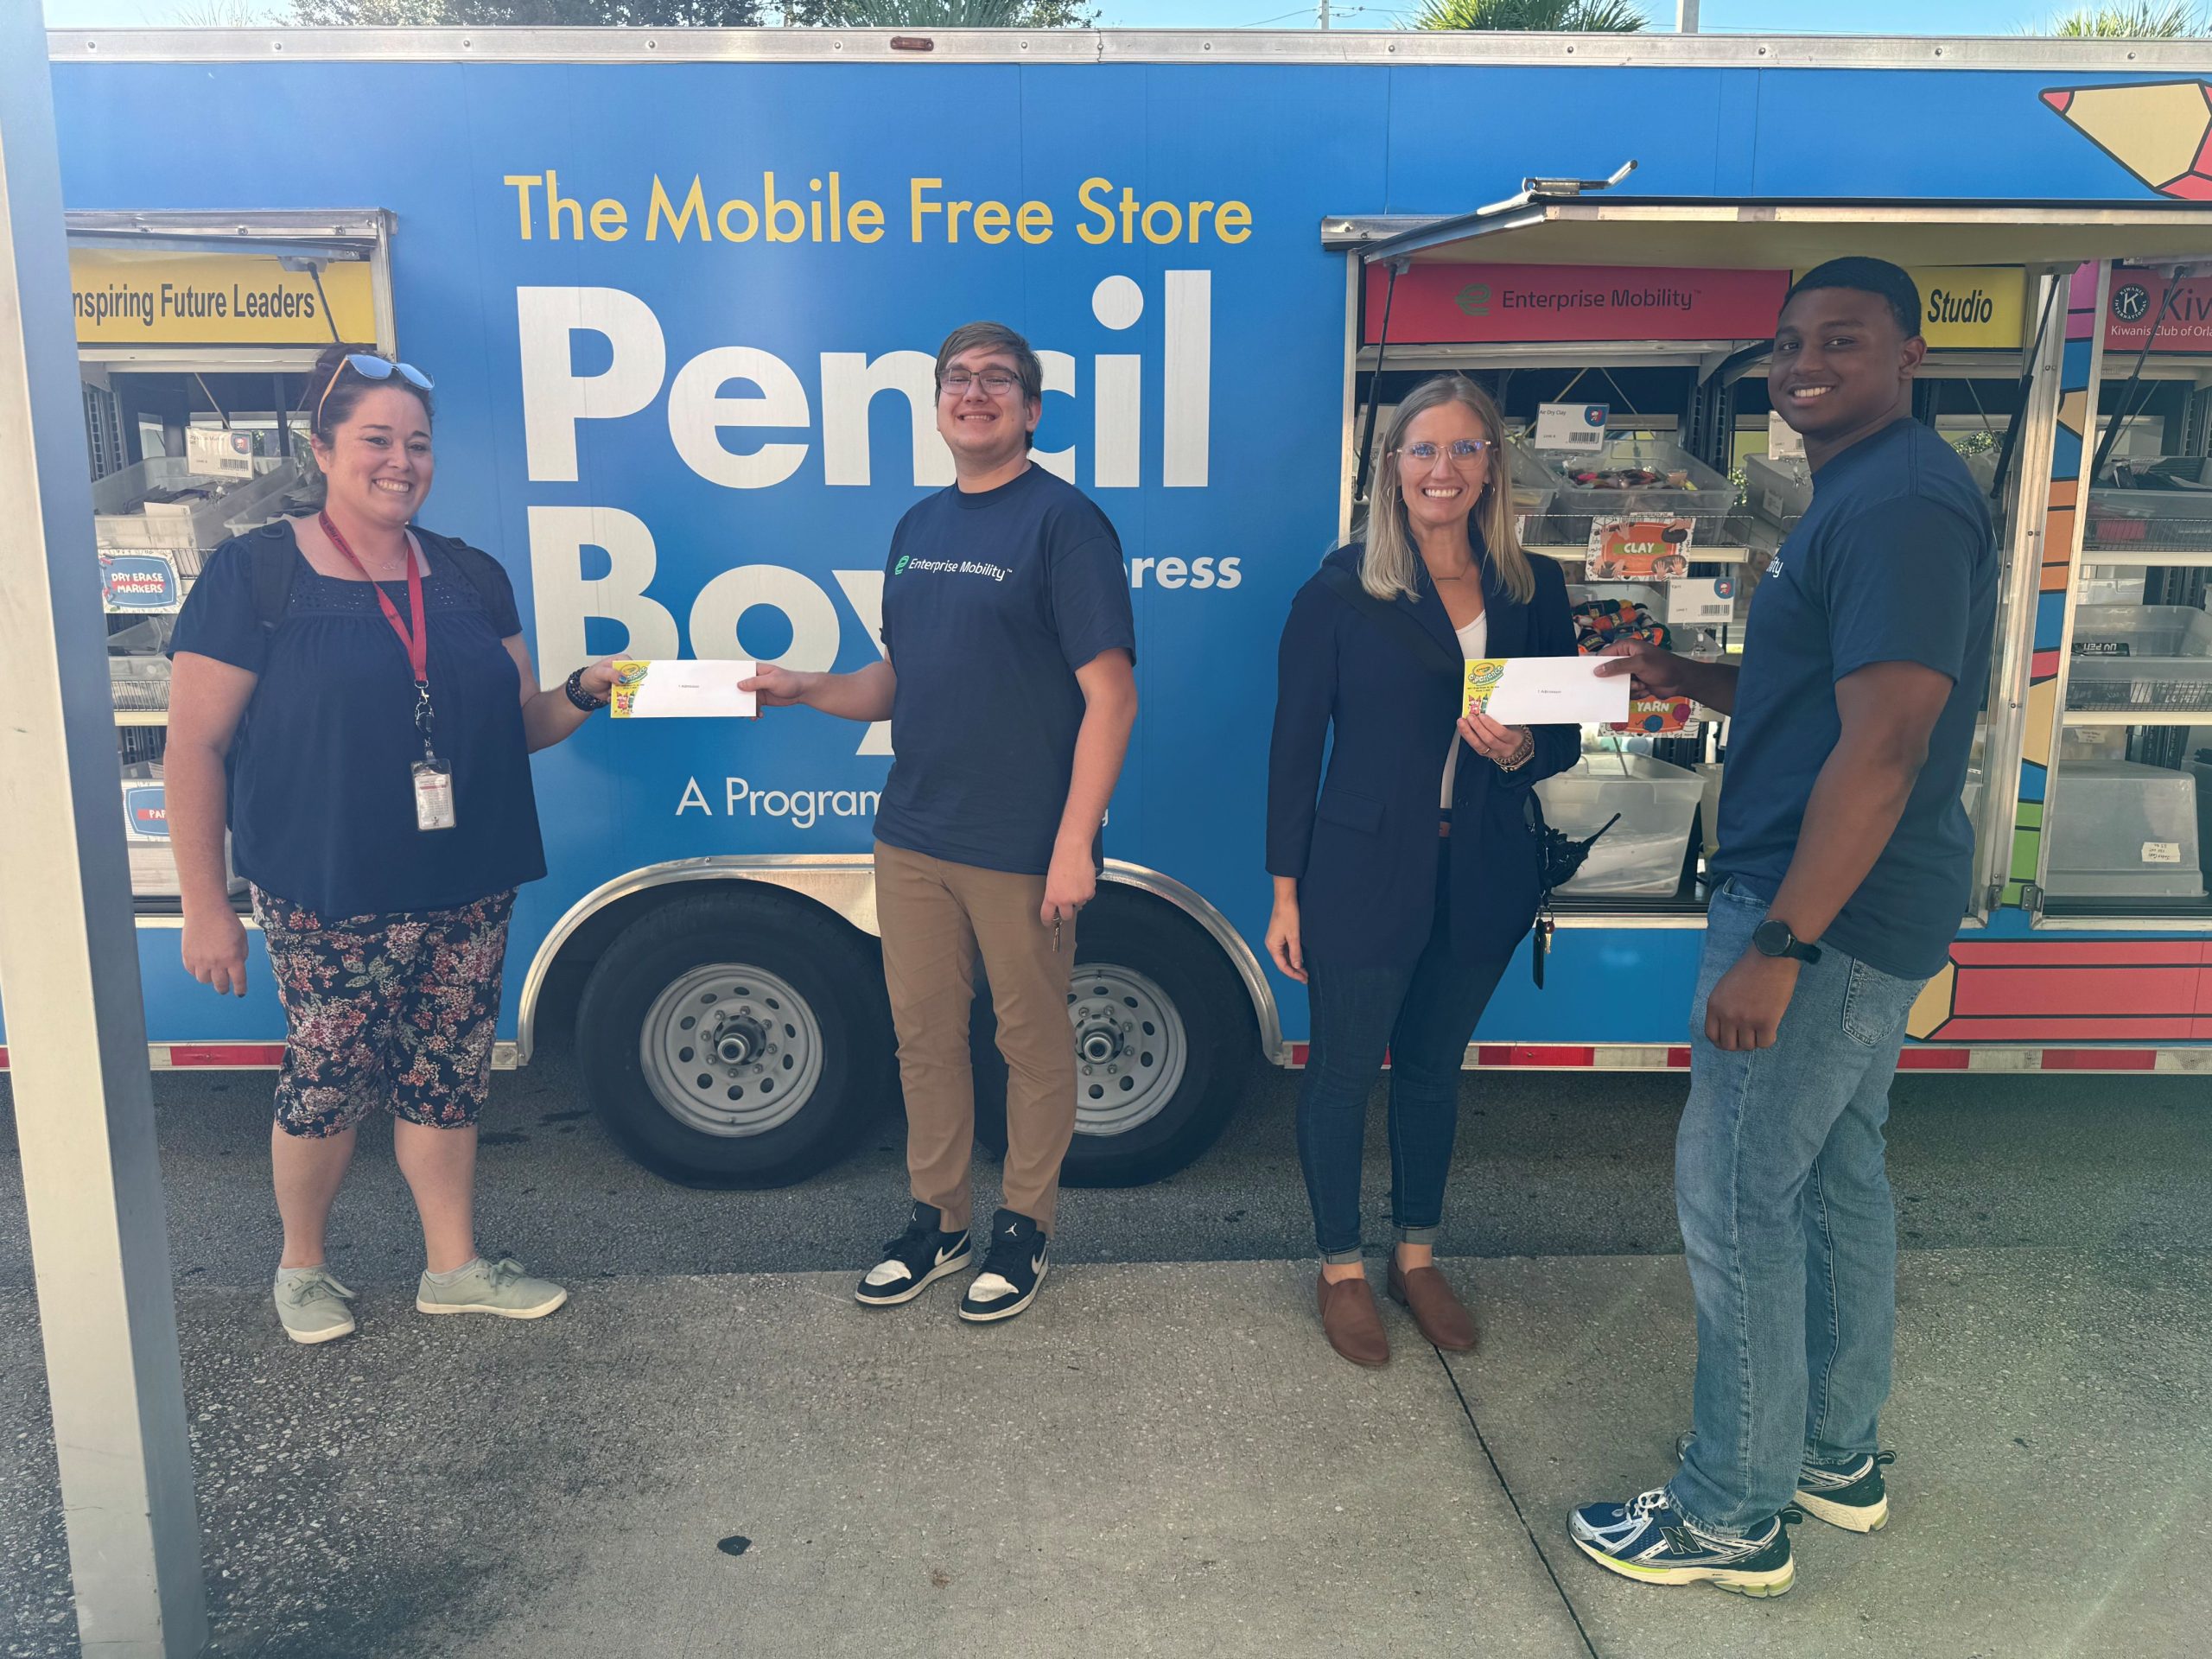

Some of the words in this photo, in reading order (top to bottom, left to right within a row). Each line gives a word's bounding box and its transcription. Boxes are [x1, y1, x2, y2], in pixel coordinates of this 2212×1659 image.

[504, 169, 628, 242] The
[645, 171, 884, 245] Mobile
[910, 177, 1053, 245] Free
[1075, 176, 1252, 245] Store
[72, 283, 154, 327] nspiring
[161, 283, 227, 318] Future
[233, 283, 315, 319] Leaders
[1502, 289, 1605, 312] Enterprise
[1927, 289, 1993, 323] Studio
[2111, 325, 2152, 336] Kiwanis
[2180, 325, 2193, 336] of
[1624, 542, 1656, 554] CLAY
[908, 557, 958, 574] Enterprise
[1123, 556, 1243, 589] ress
[111, 572, 130, 582] DRY
[132, 572, 164, 582] ERASE
[117, 583, 163, 594] MARKERS
[1637, 700, 1670, 713] YARN
[675, 775, 713, 817] A
